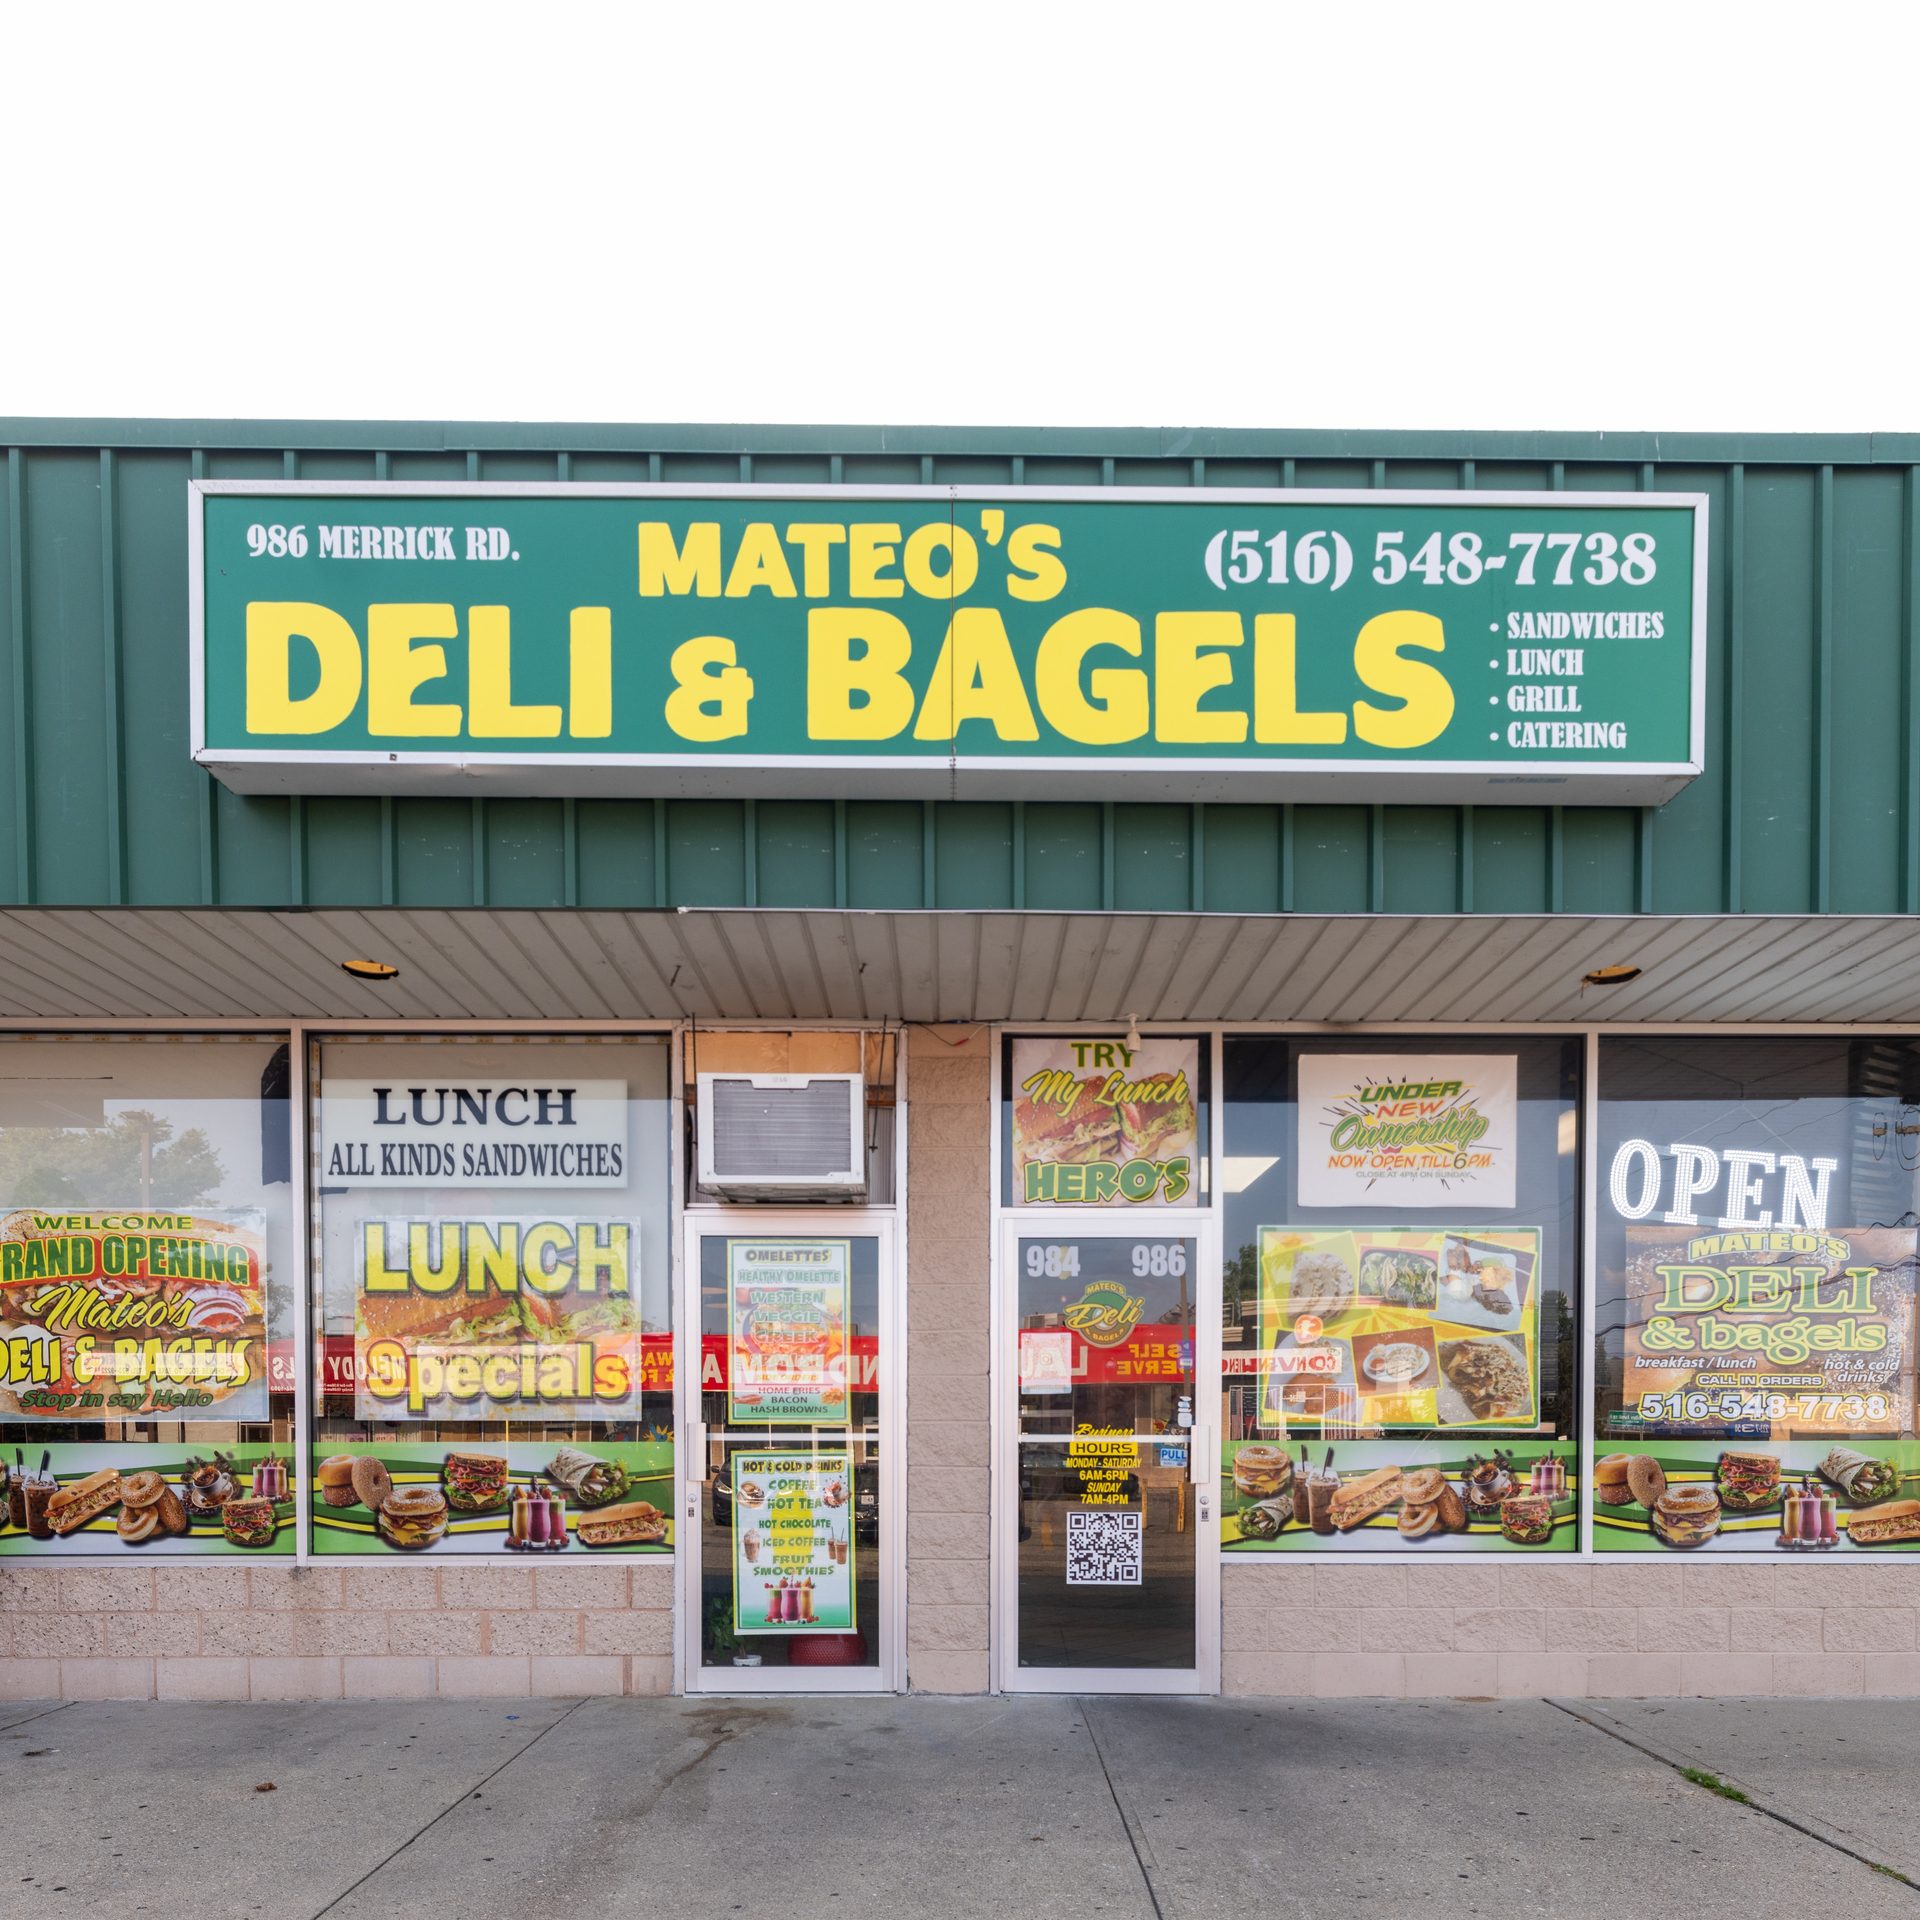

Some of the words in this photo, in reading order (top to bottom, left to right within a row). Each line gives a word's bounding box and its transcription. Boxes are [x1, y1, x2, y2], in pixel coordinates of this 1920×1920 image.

[247, 524, 308, 558] 986
[318, 525, 456, 561] MERRICK
[465, 527, 520, 561] RD.
[638, 509, 1067, 602] MATEO'S
[1205, 530, 1353, 591] (516)
[1373, 530, 1656, 585] 548-7738
[1507, 612, 1664, 641] SANDWICHES
[1507, 650, 1584, 677] LUNCH
[246, 602, 612, 737] DELI
[665, 636, 754, 742] &
[807, 606, 1455, 748] BAGELS
[1507, 686, 1582, 713] GRILL
[1507, 722, 1627, 750] CATERING
[1071, 1043, 1134, 1068] TRY
[1022, 1069, 1084, 1117] My
[1094, 1069, 1189, 1106] Lunch
[1360, 1081, 1463, 1103] UNDER
[373, 1088, 577, 1126] LUNCH
[1376, 1101, 1444, 1118] NEW
[1330, 1108, 1489, 1151] Ownership
[328, 1143, 375, 1176] ALL
[381, 1143, 456, 1176] KINDS
[462, 1143, 623, 1177] SANDWICHES
[1328, 1155, 1367, 1168] NOW
[1371, 1155, 1416, 1169] OPEN
[1421, 1155, 1452, 1168] TILL
[1024, 1157, 1190, 1203] HERO'S
[1609, 1138, 1838, 1229] OPEN
[33, 1216, 193, 1230] WELCOME
[746, 1250, 831, 1263] OMELETTES
[1690, 1232, 1849, 1260] MATEO'S
[0, 1236, 95, 1283] RAND
[102, 1234, 250, 1286] OPENING
[364, 1221, 630, 1294] LUNCH
[1026, 1245, 1081, 1278] 984
[1132, 1244, 1187, 1277] 986
[738, 1269, 783, 1283] HEALTHY
[786, 1269, 840, 1283] OMELETTE
[751, 1291, 824, 1304] WESTERN
[1087, 1281, 1125, 1295] MATEO'S
[1655, 1265, 1878, 1313] DELI
[30, 1284, 196, 1333] Mateo's
[754, 1311, 819, 1323] VEGGIE
[1065, 1298, 1144, 1328] Deli
[755, 1330, 818, 1342] GREEK
[1641, 1316, 1695, 1349] &
[1697, 1316, 1887, 1365] bagels
[73, 1335, 97, 1387] &
[114, 1337, 252, 1388] BAGELS
[1635, 1356, 1707, 1369] breakfast
[1716, 1356, 1757, 1369] lunch
[1824, 1359, 1849, 1371] hot
[1851, 1360, 1865, 1371] &
[1868, 1359, 1900, 1371] cold
[366, 1339, 632, 1413] Specials
[1700, 1375, 1737, 1385] CALL
[1741, 1375, 1755, 1385] IN
[1760, 1375, 1822, 1385] ORDERS
[1837, 1371, 1884, 1383] drinks
[20, 1390, 77, 1412] Stop
[80, 1389, 103, 1407] in
[107, 1393, 150, 1412] say
[151, 1389, 213, 1407] Hello
[1641, 1394, 1888, 1420] 516-548-7738
[1074, 1423, 1134, 1438] Business
[1076, 1443, 1132, 1453] HOURS
[1161, 1449, 1187, 1459] PULL
[743, 1461, 765, 1472] HOT
[776, 1461, 802, 1472] COLD
[1079, 1470, 1128, 1480] 6AM-6PM
[769, 1479, 816, 1490] COFFEE
[1087, 1482, 1121, 1492] SUNDAY
[767, 1498, 794, 1509] HOT
[799, 1497, 822, 1509] TEA
[1080, 1494, 1128, 1504] 7AM-4PM
[759, 1519, 776, 1528] HOT
[780, 1519, 831, 1528] CHOCOLATE
[763, 1538, 785, 1547] ICED
[788, 1537, 826, 1546] COFFEE
[773, 1555, 814, 1564] FRUIT
[753, 1566, 834, 1576] SMOOTHIES
